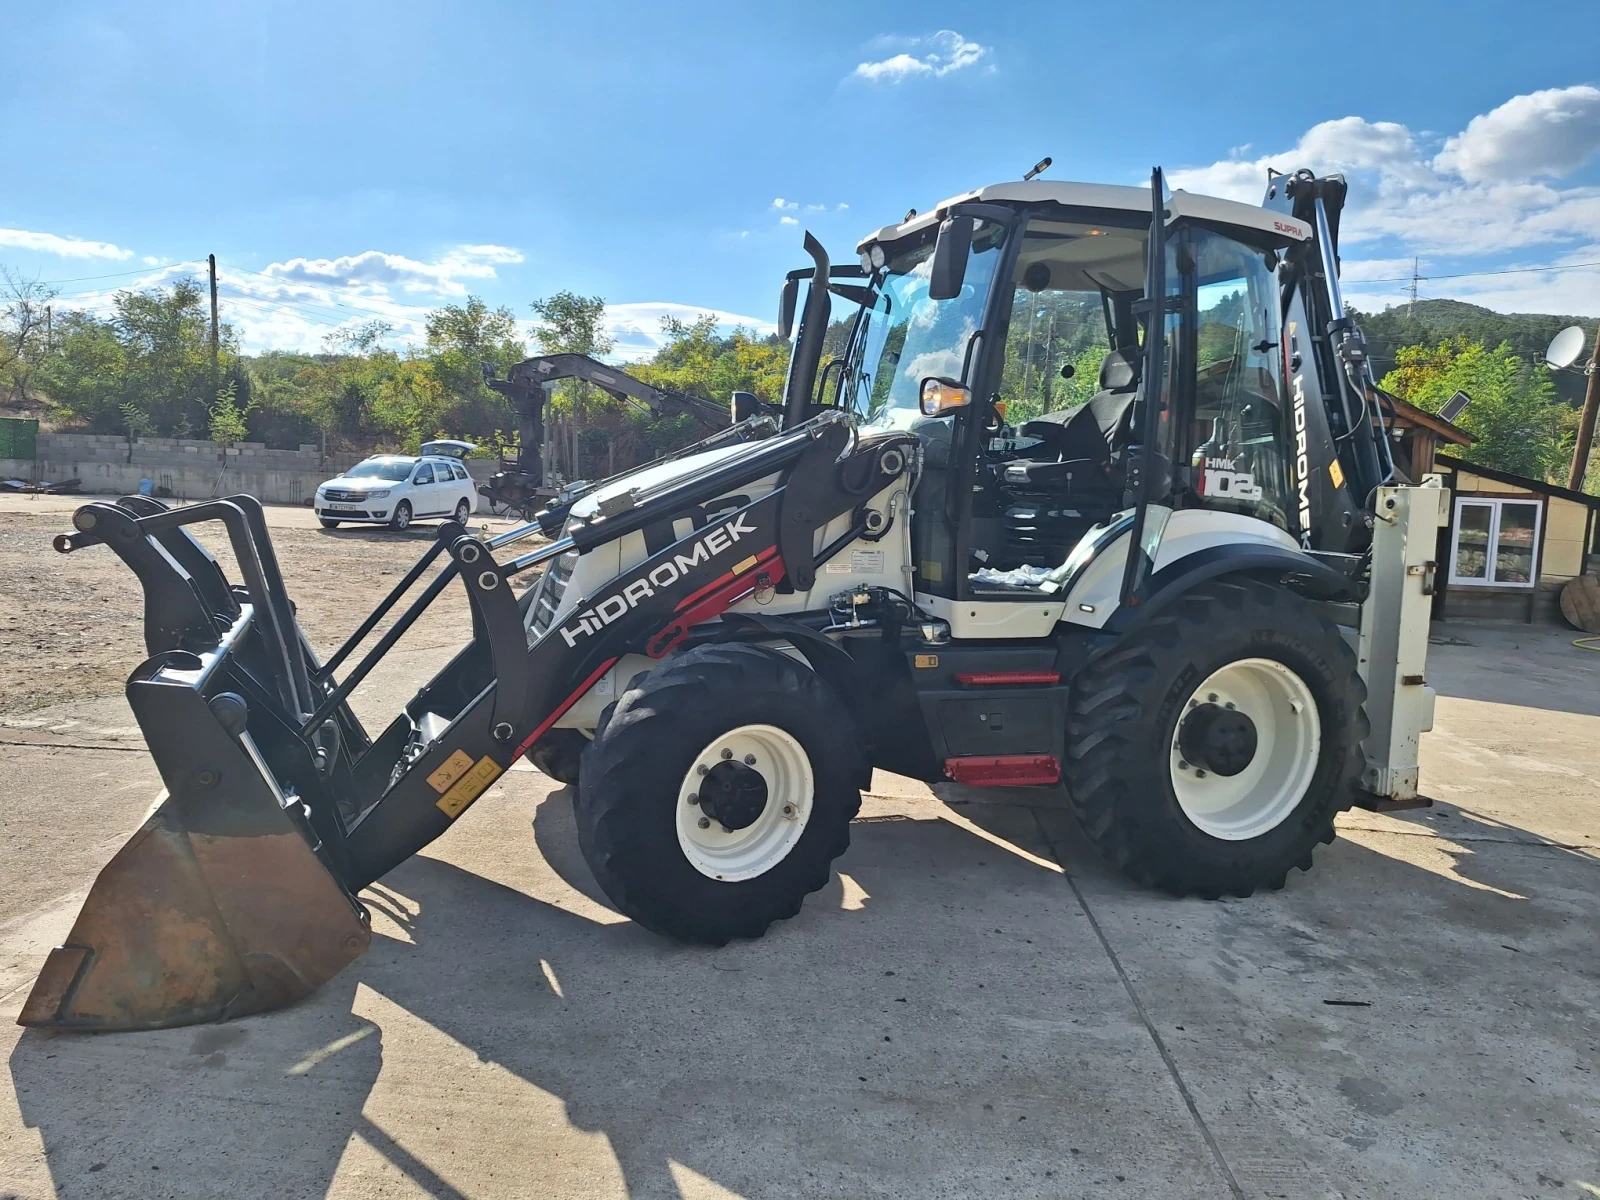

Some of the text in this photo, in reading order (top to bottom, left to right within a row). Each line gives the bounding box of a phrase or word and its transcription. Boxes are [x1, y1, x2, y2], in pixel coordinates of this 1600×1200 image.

[1274, 221, 1303, 238] SUPRA
[1204, 457, 1236, 470] HMK
[1292, 374, 1312, 549] HIDROMEK
[559, 511, 758, 648] HIDROMEK
